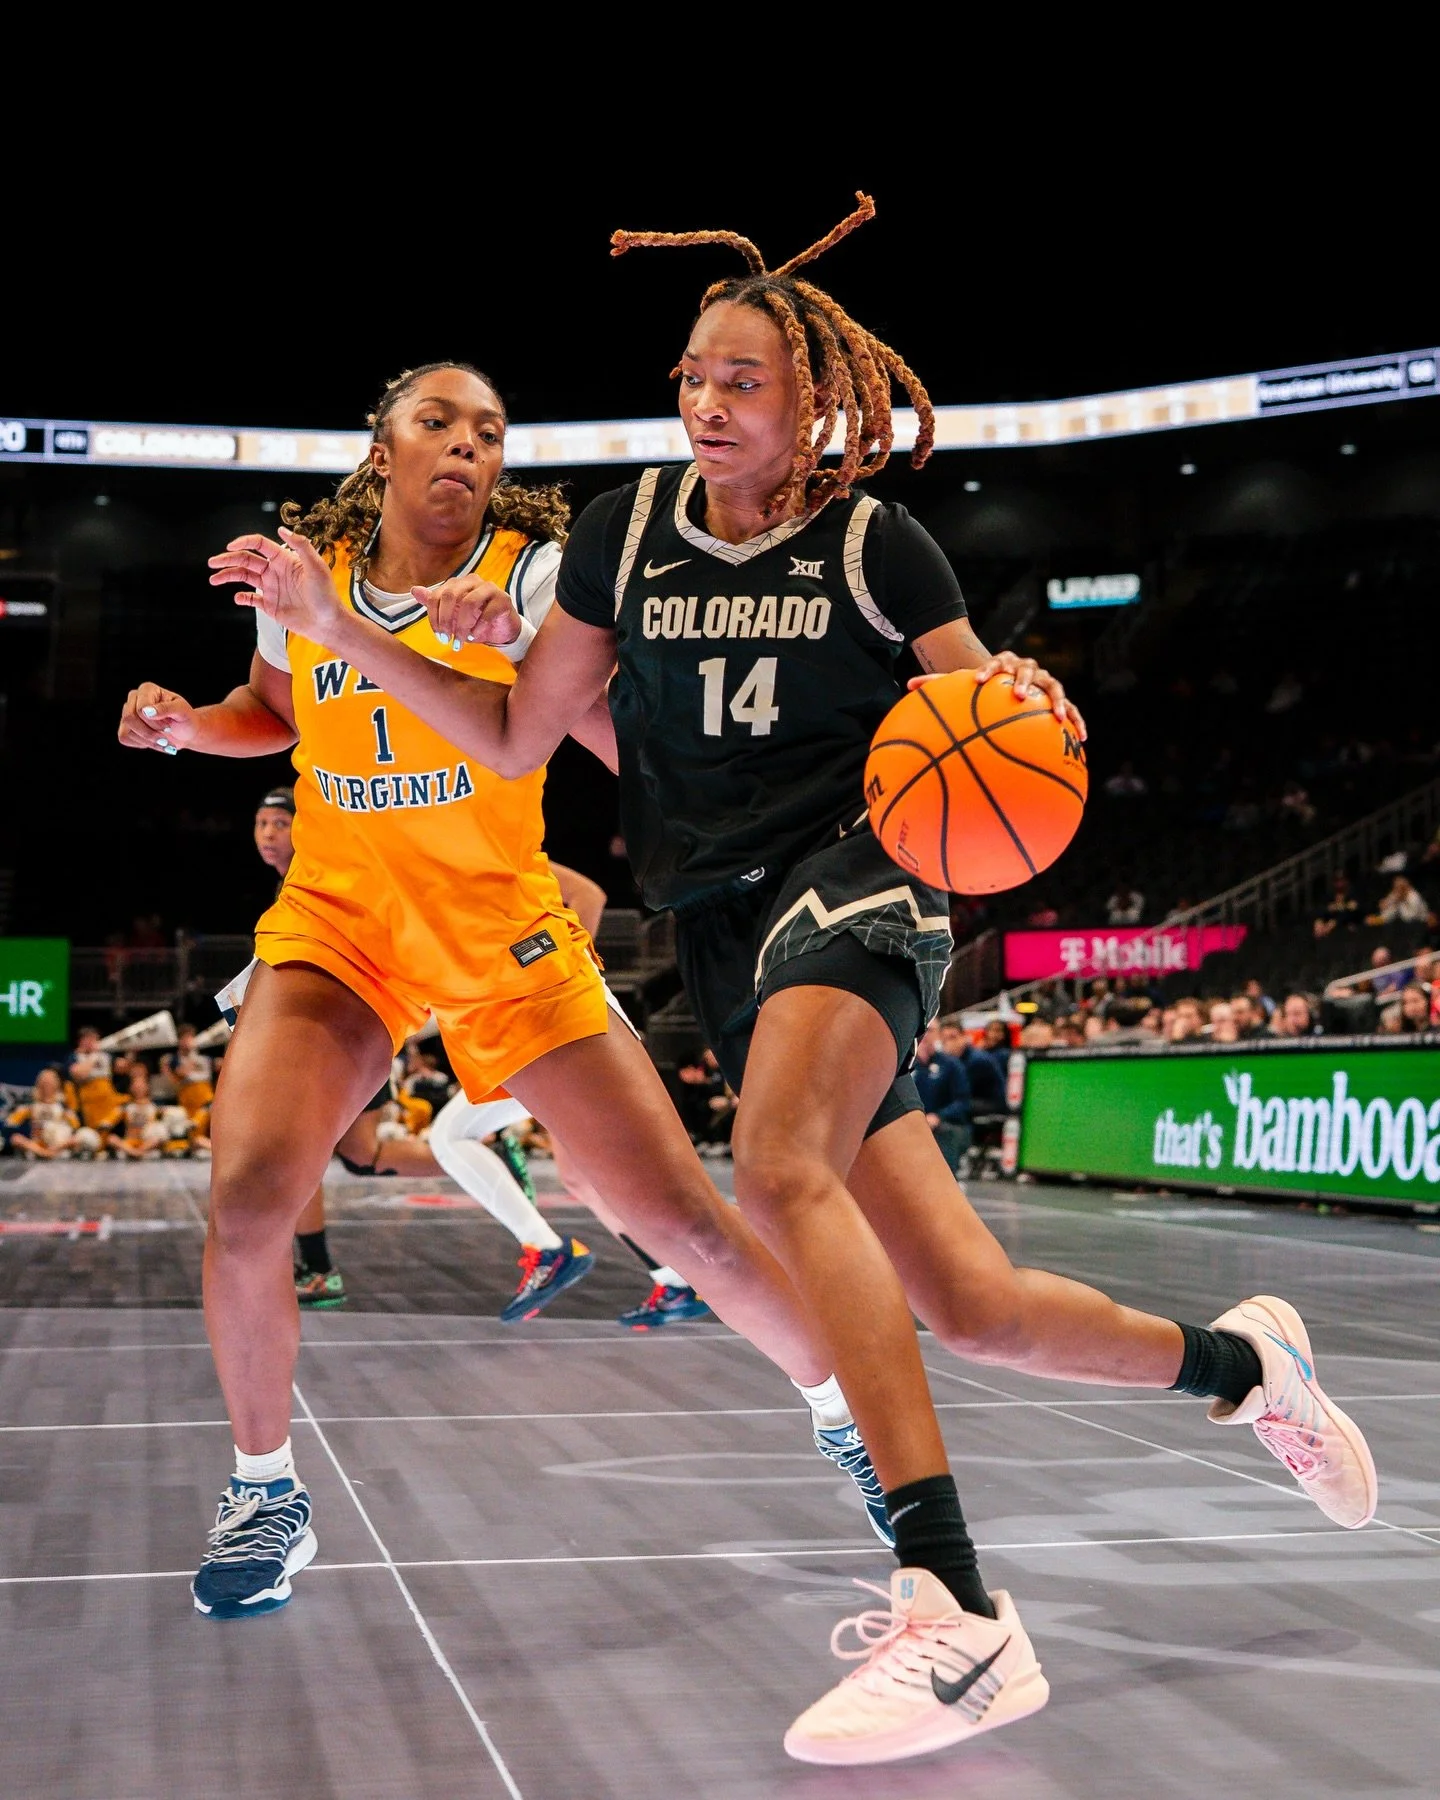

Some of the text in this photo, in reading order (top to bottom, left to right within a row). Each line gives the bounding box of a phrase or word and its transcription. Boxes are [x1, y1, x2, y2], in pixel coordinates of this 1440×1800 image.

[642, 596, 832, 640] COLORADO
[698, 657, 779, 737] 14
[371, 706, 395, 764] 1
[312, 761, 475, 813] VIRGINIA
[1153, 1108, 1223, 1169] that's
